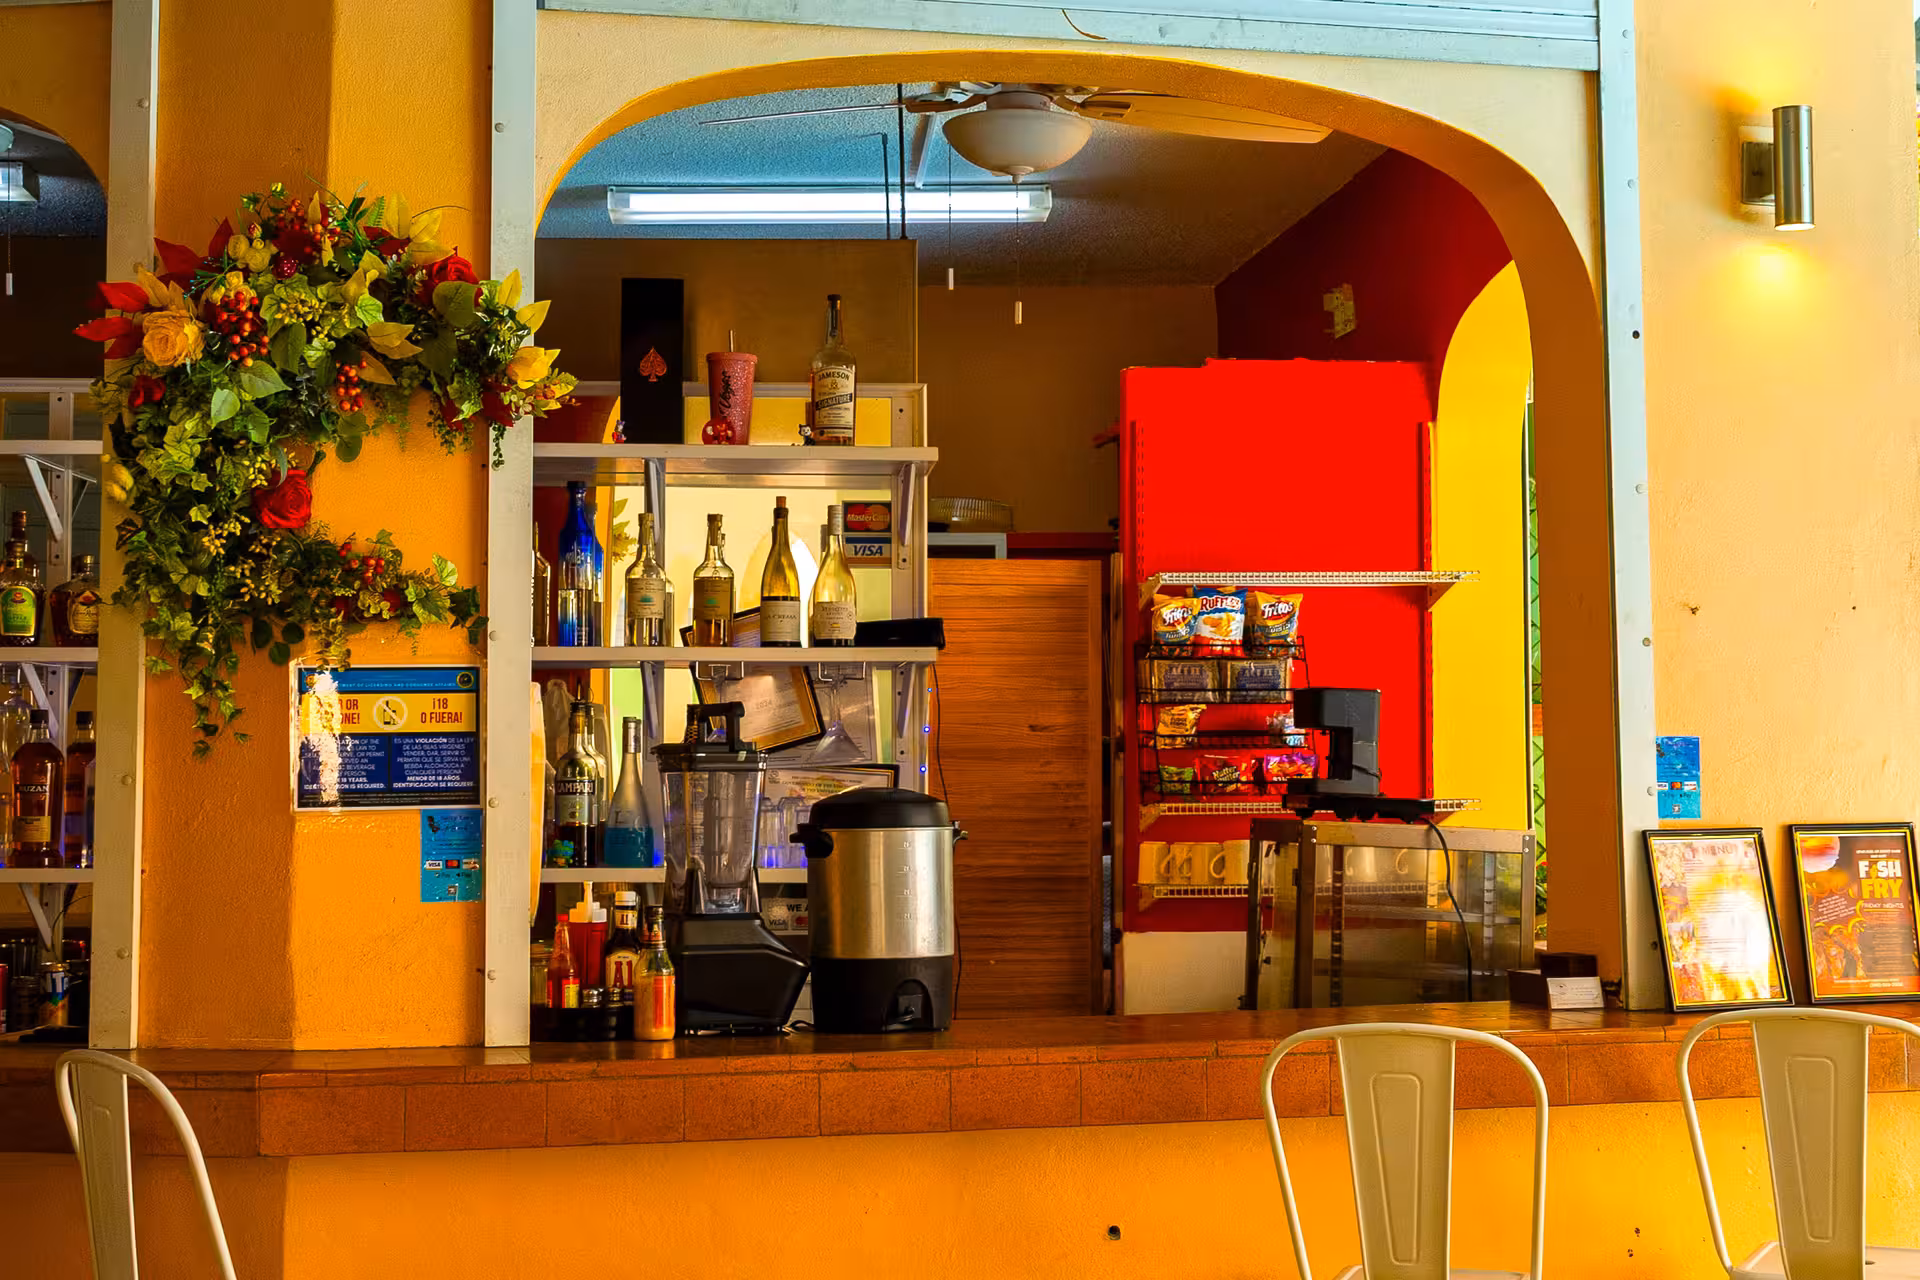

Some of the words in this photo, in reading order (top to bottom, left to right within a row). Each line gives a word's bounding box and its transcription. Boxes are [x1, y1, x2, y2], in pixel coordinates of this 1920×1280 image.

[818, 371, 850, 381] JAMESON
[819, 393, 852, 407] SIGNATURE
[853, 545, 883, 556] VISA
[1261, 602, 1294, 618] Fritos
[1164, 607, 1192, 625] Fritos
[346, 699, 358, 710] OR
[420, 712, 426, 723] O
[430, 712, 462, 723] FUERA!
[1861, 879, 1903, 898] FRY
[786, 903, 802, 912] WE
